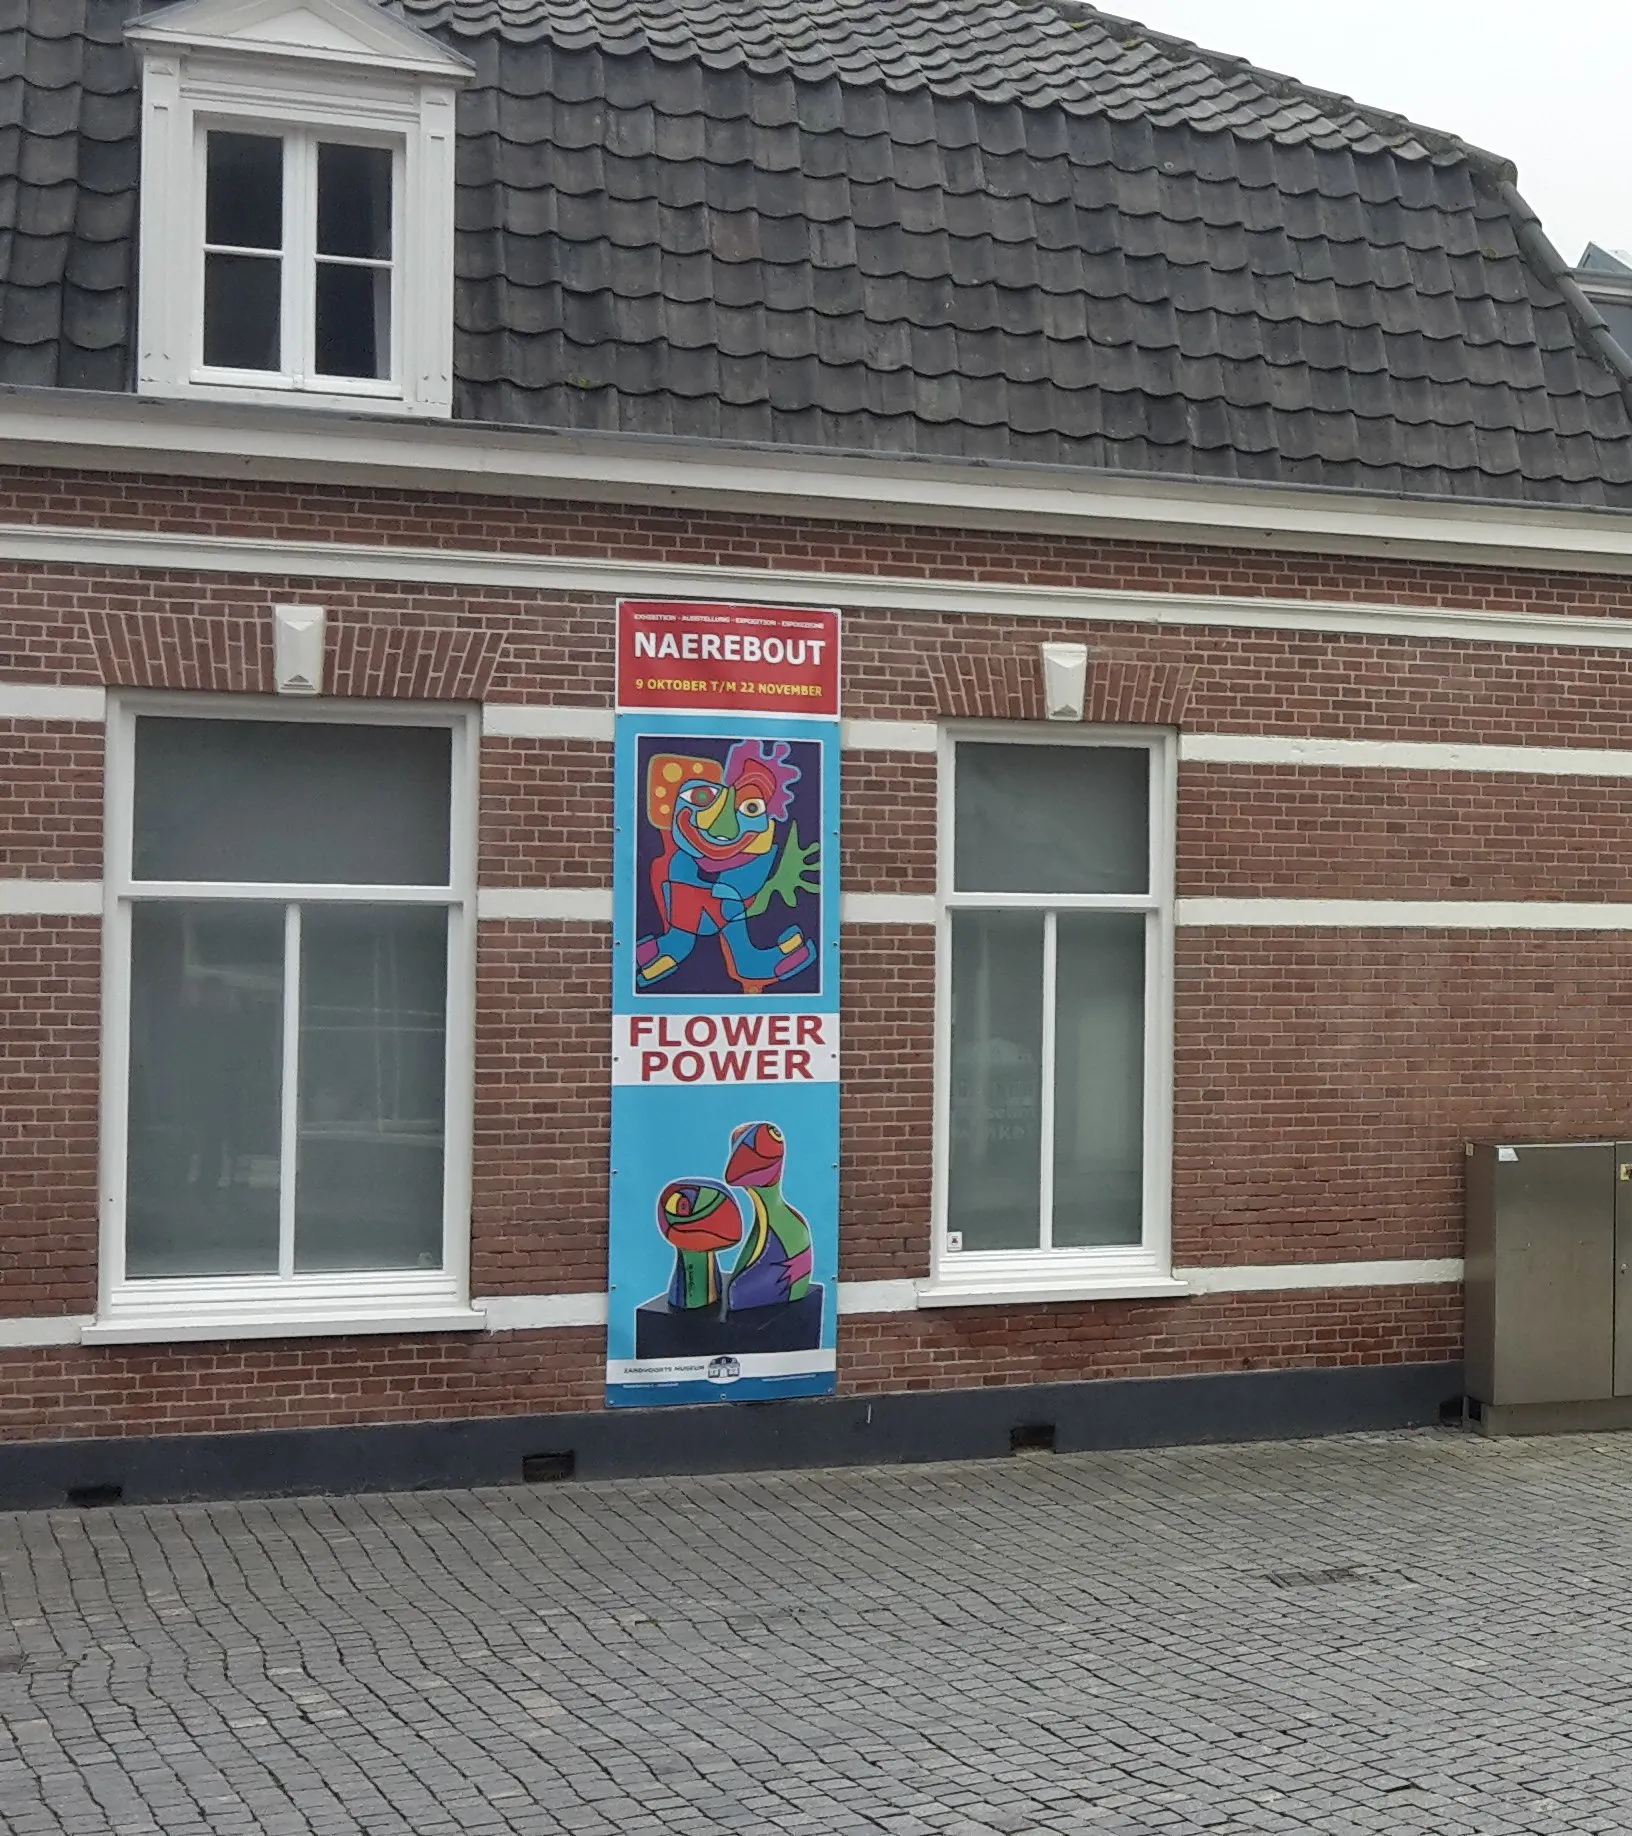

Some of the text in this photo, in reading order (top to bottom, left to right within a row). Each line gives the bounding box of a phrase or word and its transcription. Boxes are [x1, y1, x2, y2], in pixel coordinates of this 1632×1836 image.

[634, 631, 826, 666] NAEREBOUT
[635, 678, 823, 697] 9 OKTOBER T/M 22 NOVEMBER
[630, 1014, 826, 1048] FLOWER
[641, 1050, 815, 1082] POWER
[674, 1364, 705, 1373] MUSEUM
